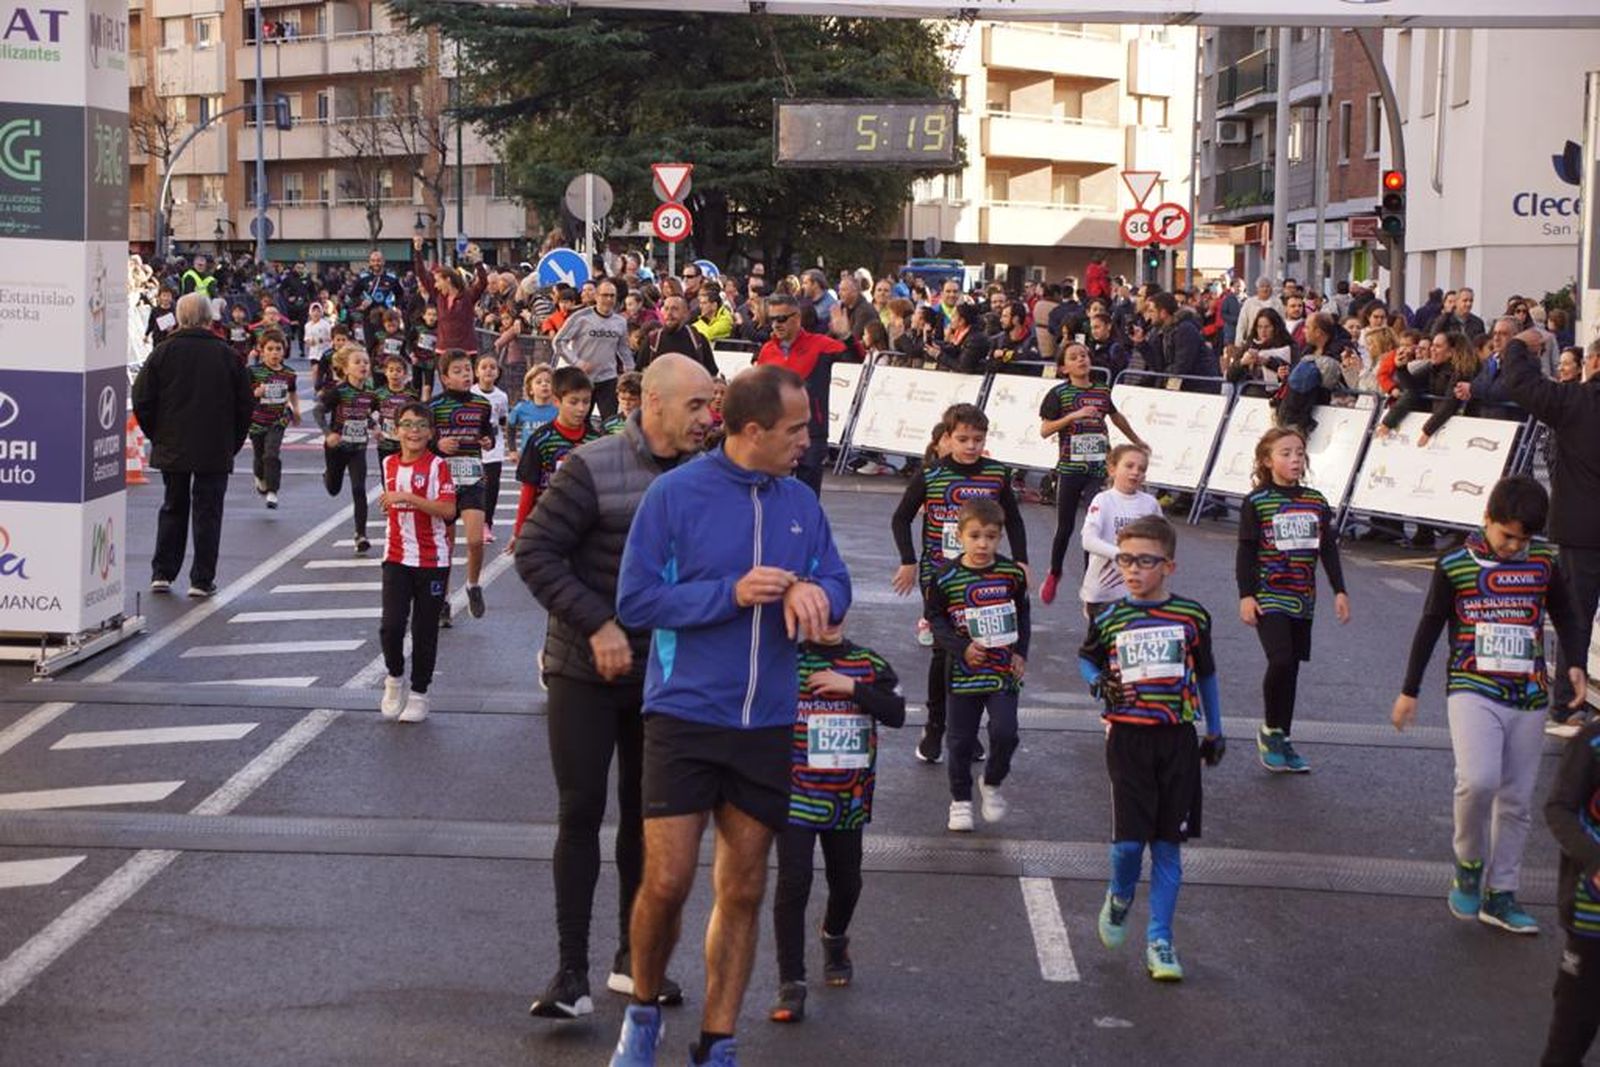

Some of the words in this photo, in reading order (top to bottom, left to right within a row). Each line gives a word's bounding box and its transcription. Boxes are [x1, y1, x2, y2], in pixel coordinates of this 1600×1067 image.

[856, 114, 946, 151] 5:19
[660, 216, 683, 231] 30
[1128, 221, 1150, 234] 30
[1541, 222, 1572, 236] San
[0, 288, 76, 306] Estanislao
[977, 614, 1006, 636] 6191
[1126, 639, 1171, 665] 6432
[1482, 635, 1525, 657] 6400
[818, 728, 861, 750] 6225
